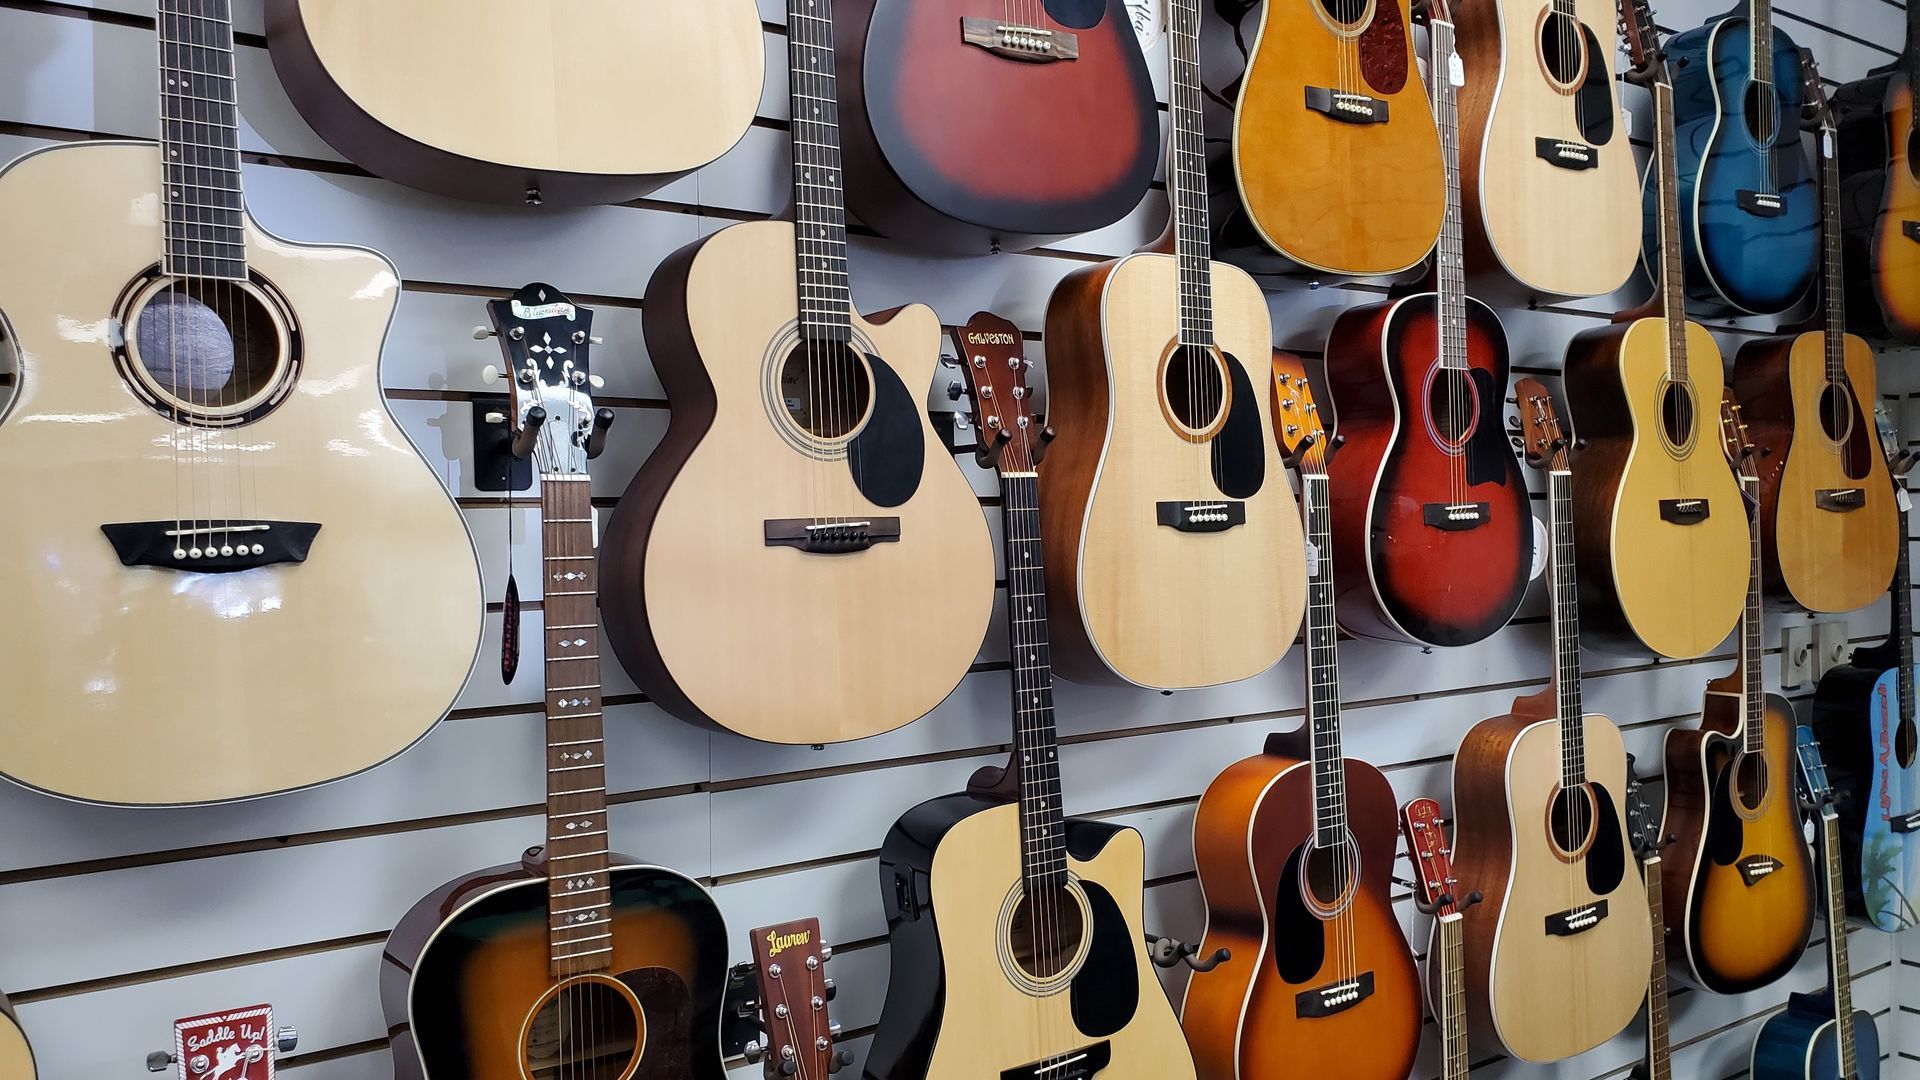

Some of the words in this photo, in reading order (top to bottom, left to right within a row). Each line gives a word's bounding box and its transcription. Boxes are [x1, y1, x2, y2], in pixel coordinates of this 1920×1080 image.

[766, 929, 811, 958] Lauren
[187, 1026, 236, 1053] Saddle
[240, 1023, 266, 1044] Up!
